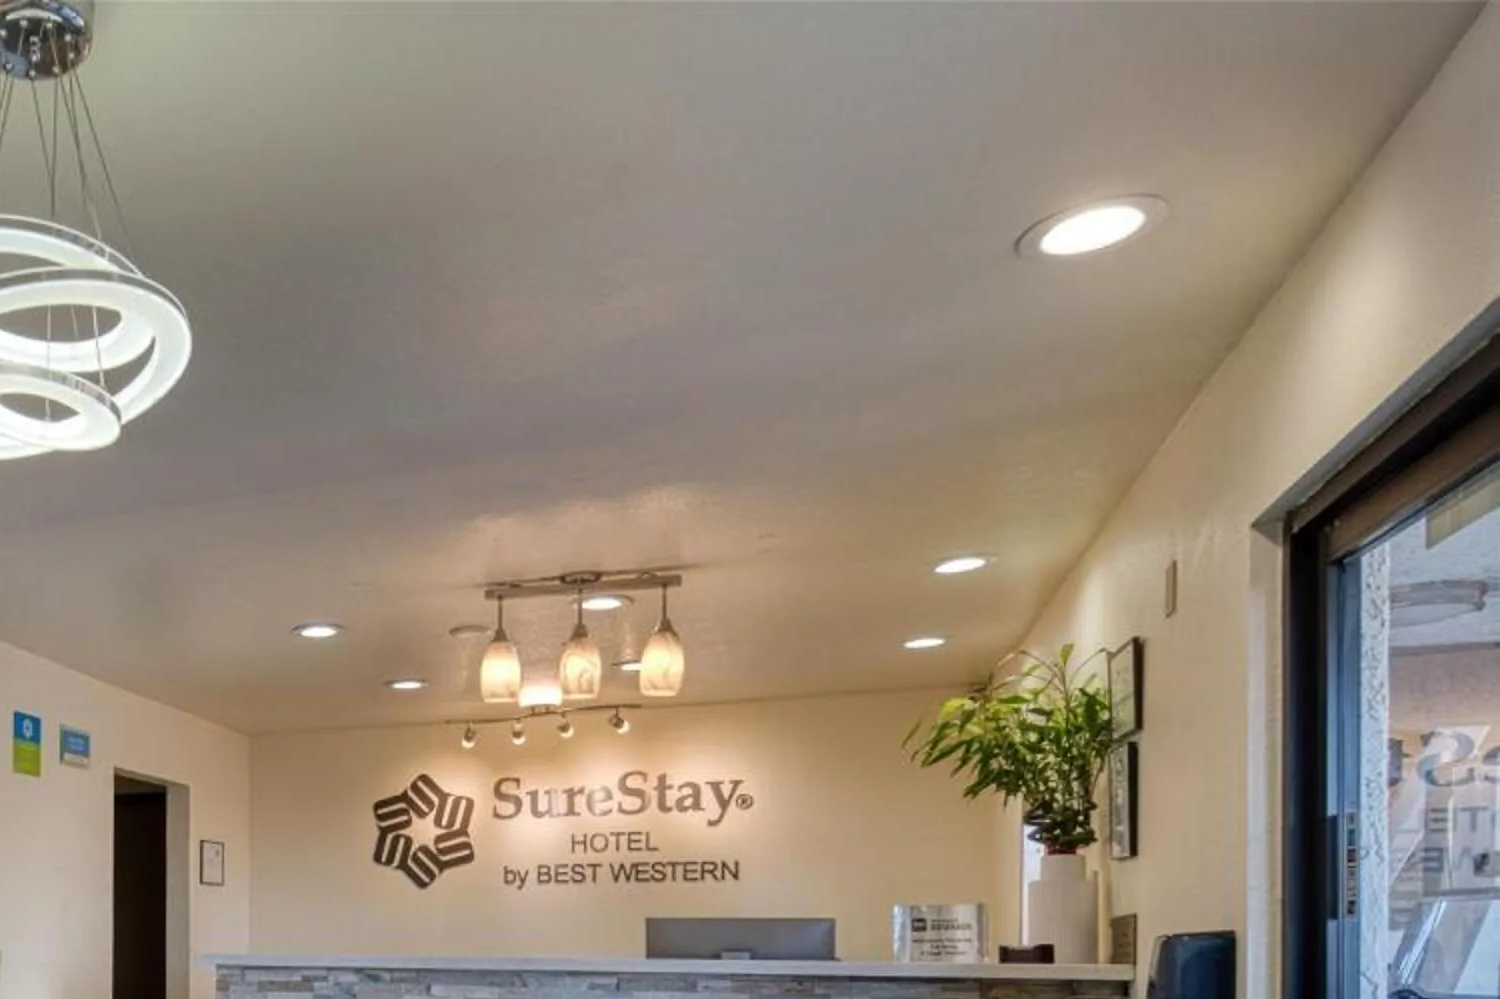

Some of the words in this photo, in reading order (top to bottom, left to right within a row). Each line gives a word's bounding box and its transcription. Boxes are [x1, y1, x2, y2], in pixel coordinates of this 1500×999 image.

[570, 831, 660, 854] HOTEL
[503, 865, 529, 890] by
[536, 863, 603, 885] BEST
[609, 860, 741, 883] WESTERN
